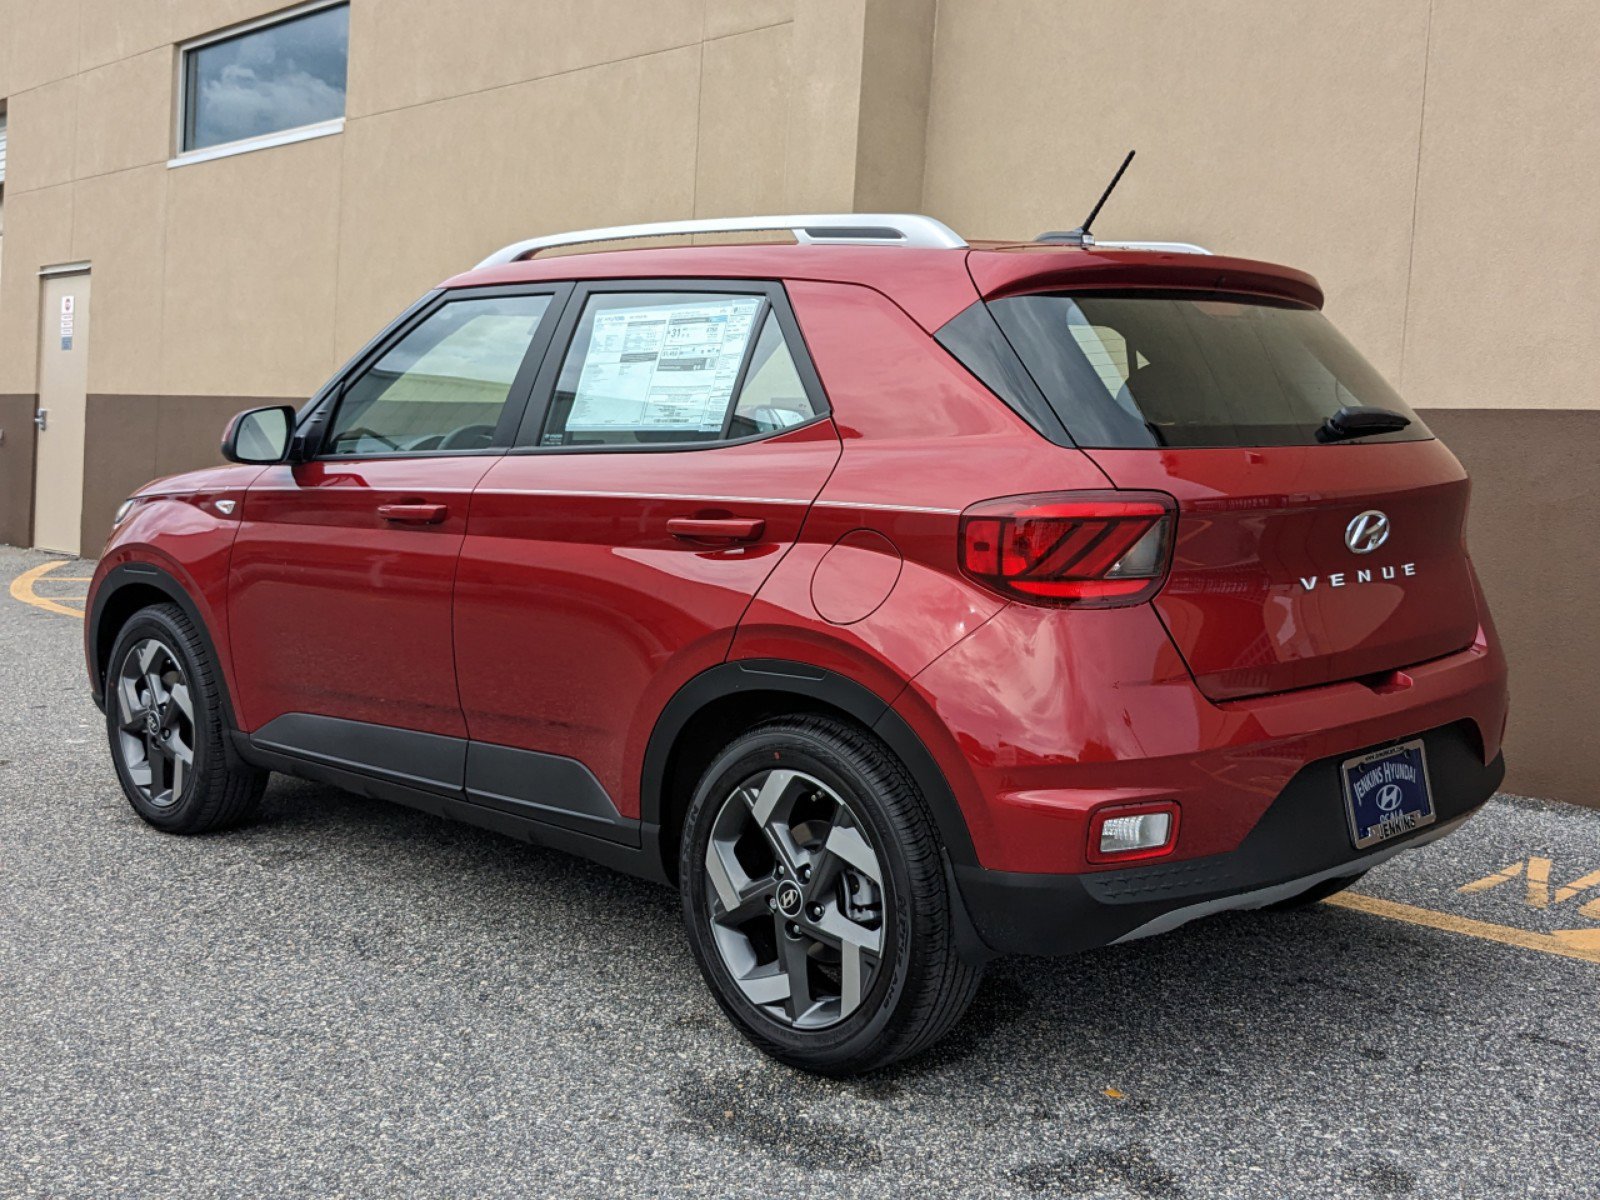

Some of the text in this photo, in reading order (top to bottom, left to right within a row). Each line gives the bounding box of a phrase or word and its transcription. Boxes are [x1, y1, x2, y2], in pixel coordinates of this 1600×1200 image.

[1299, 562, 1417, 591] VENUE
[1353, 765, 1383, 806] JENKINS
[1379, 814, 1416, 839] JENKINS
